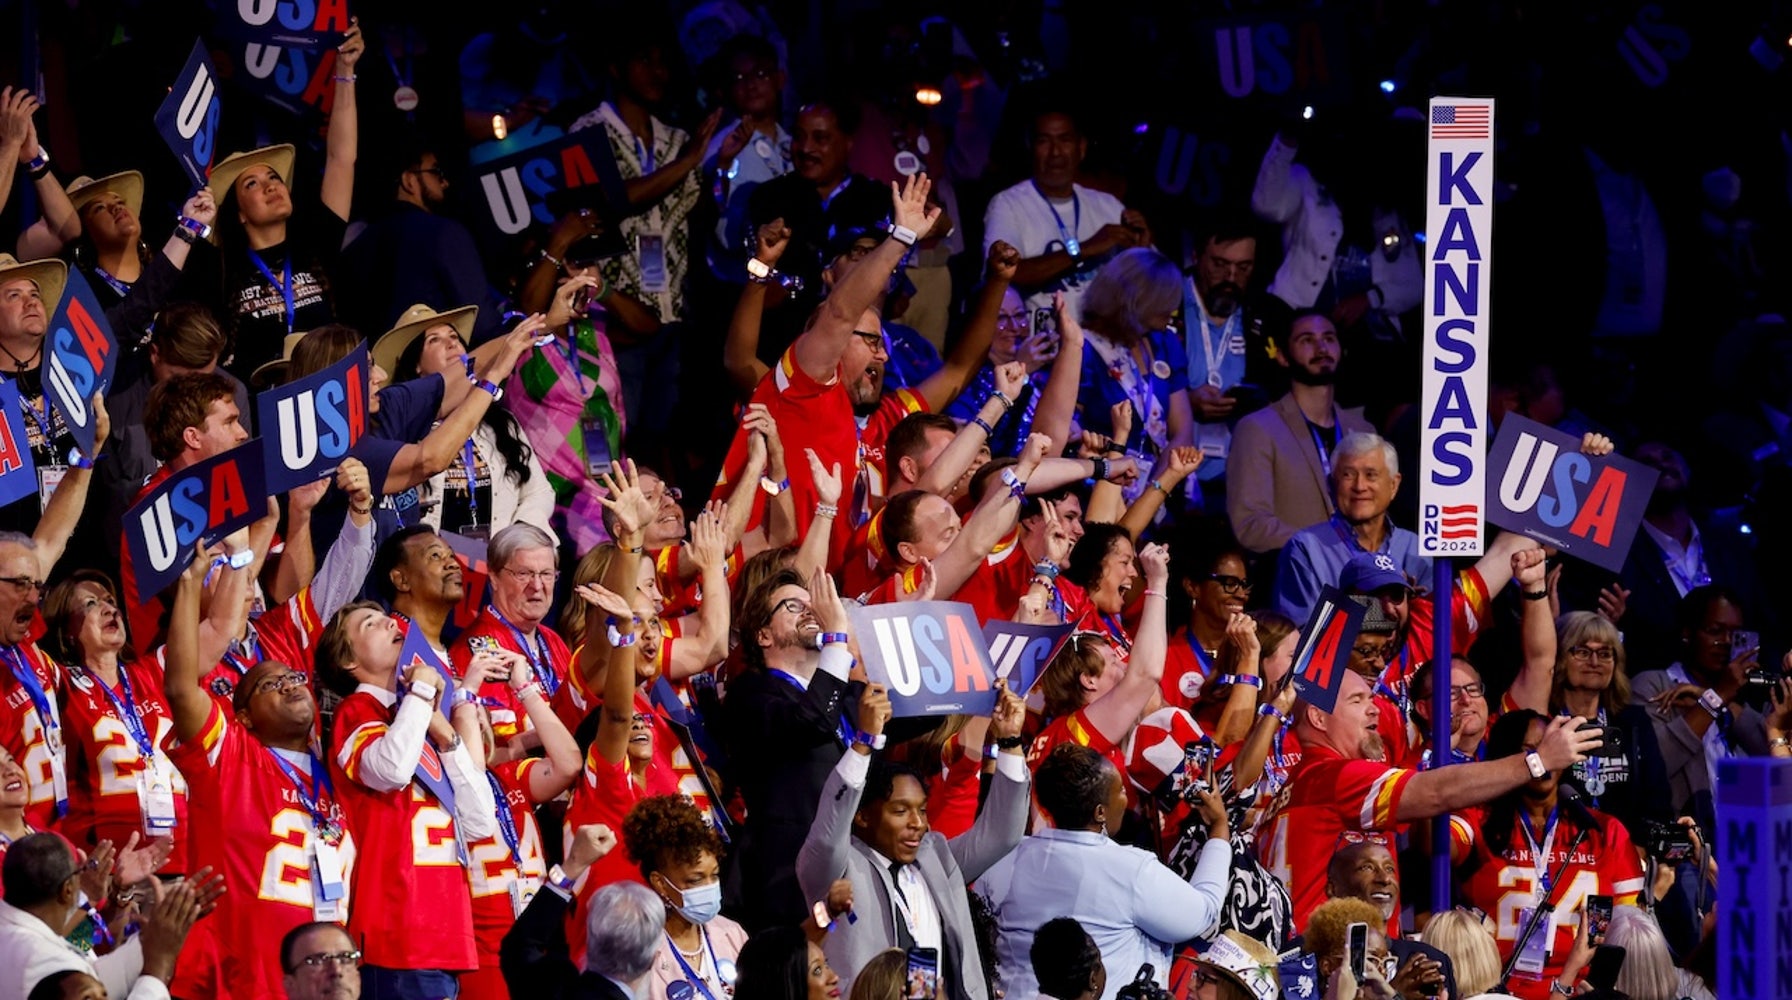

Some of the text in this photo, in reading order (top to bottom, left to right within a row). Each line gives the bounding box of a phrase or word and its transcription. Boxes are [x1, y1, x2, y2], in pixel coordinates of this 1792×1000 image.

[1215, 21, 1330, 98] USA
[177, 62, 220, 179] US
[1428, 152, 1484, 486] KANSAS
[50, 296, 110, 428] USA
[278, 364, 364, 470] USA
[140, 459, 249, 573] USA
[1424, 504, 1439, 551] DNC
[1500, 432, 1628, 548] USA
[1441, 541, 1477, 552] 2024
[872, 614, 990, 697] USA
[989, 633, 1066, 698] US
[1573, 770, 1629, 784] PREIDENT
[1496, 865, 1600, 941] 24
